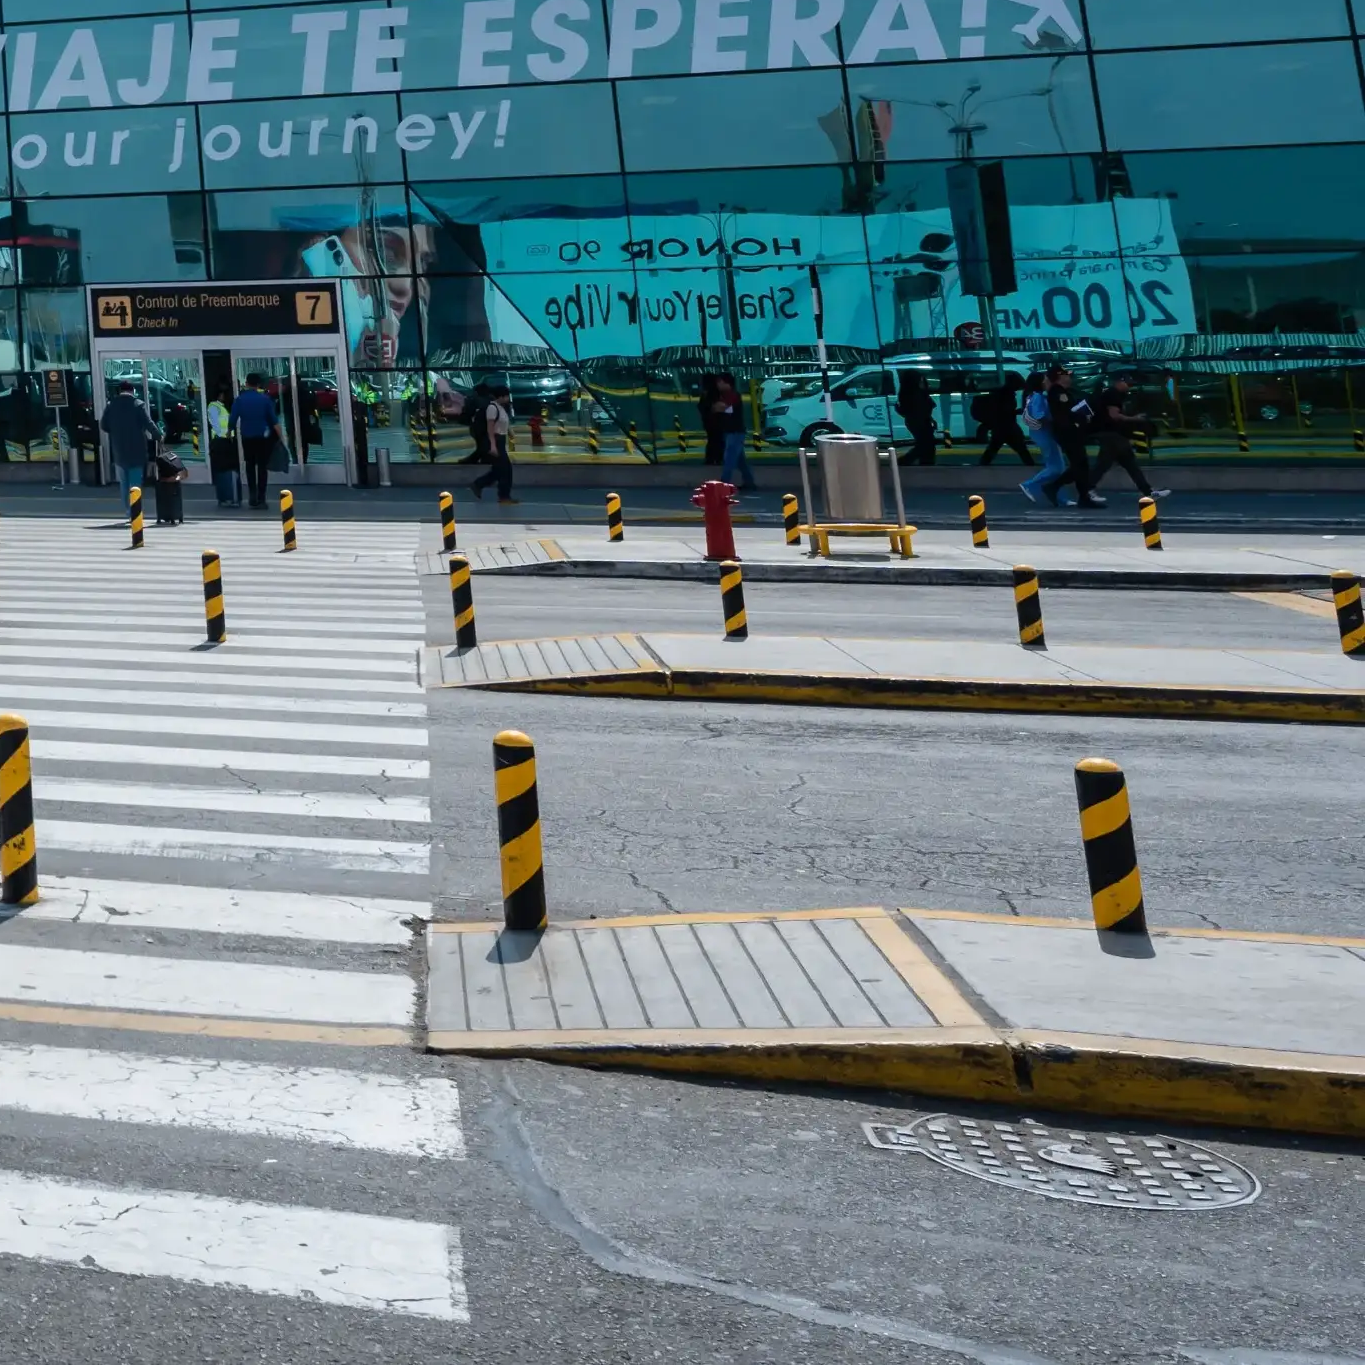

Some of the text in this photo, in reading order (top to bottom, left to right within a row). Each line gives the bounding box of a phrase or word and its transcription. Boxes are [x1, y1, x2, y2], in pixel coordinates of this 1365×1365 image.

[291, 6, 409, 97] TE
[168, 99, 513, 174] journey!
[136, 292, 321, 321] Control de Preembarque 7
[137, 316, 178, 329] Check In
